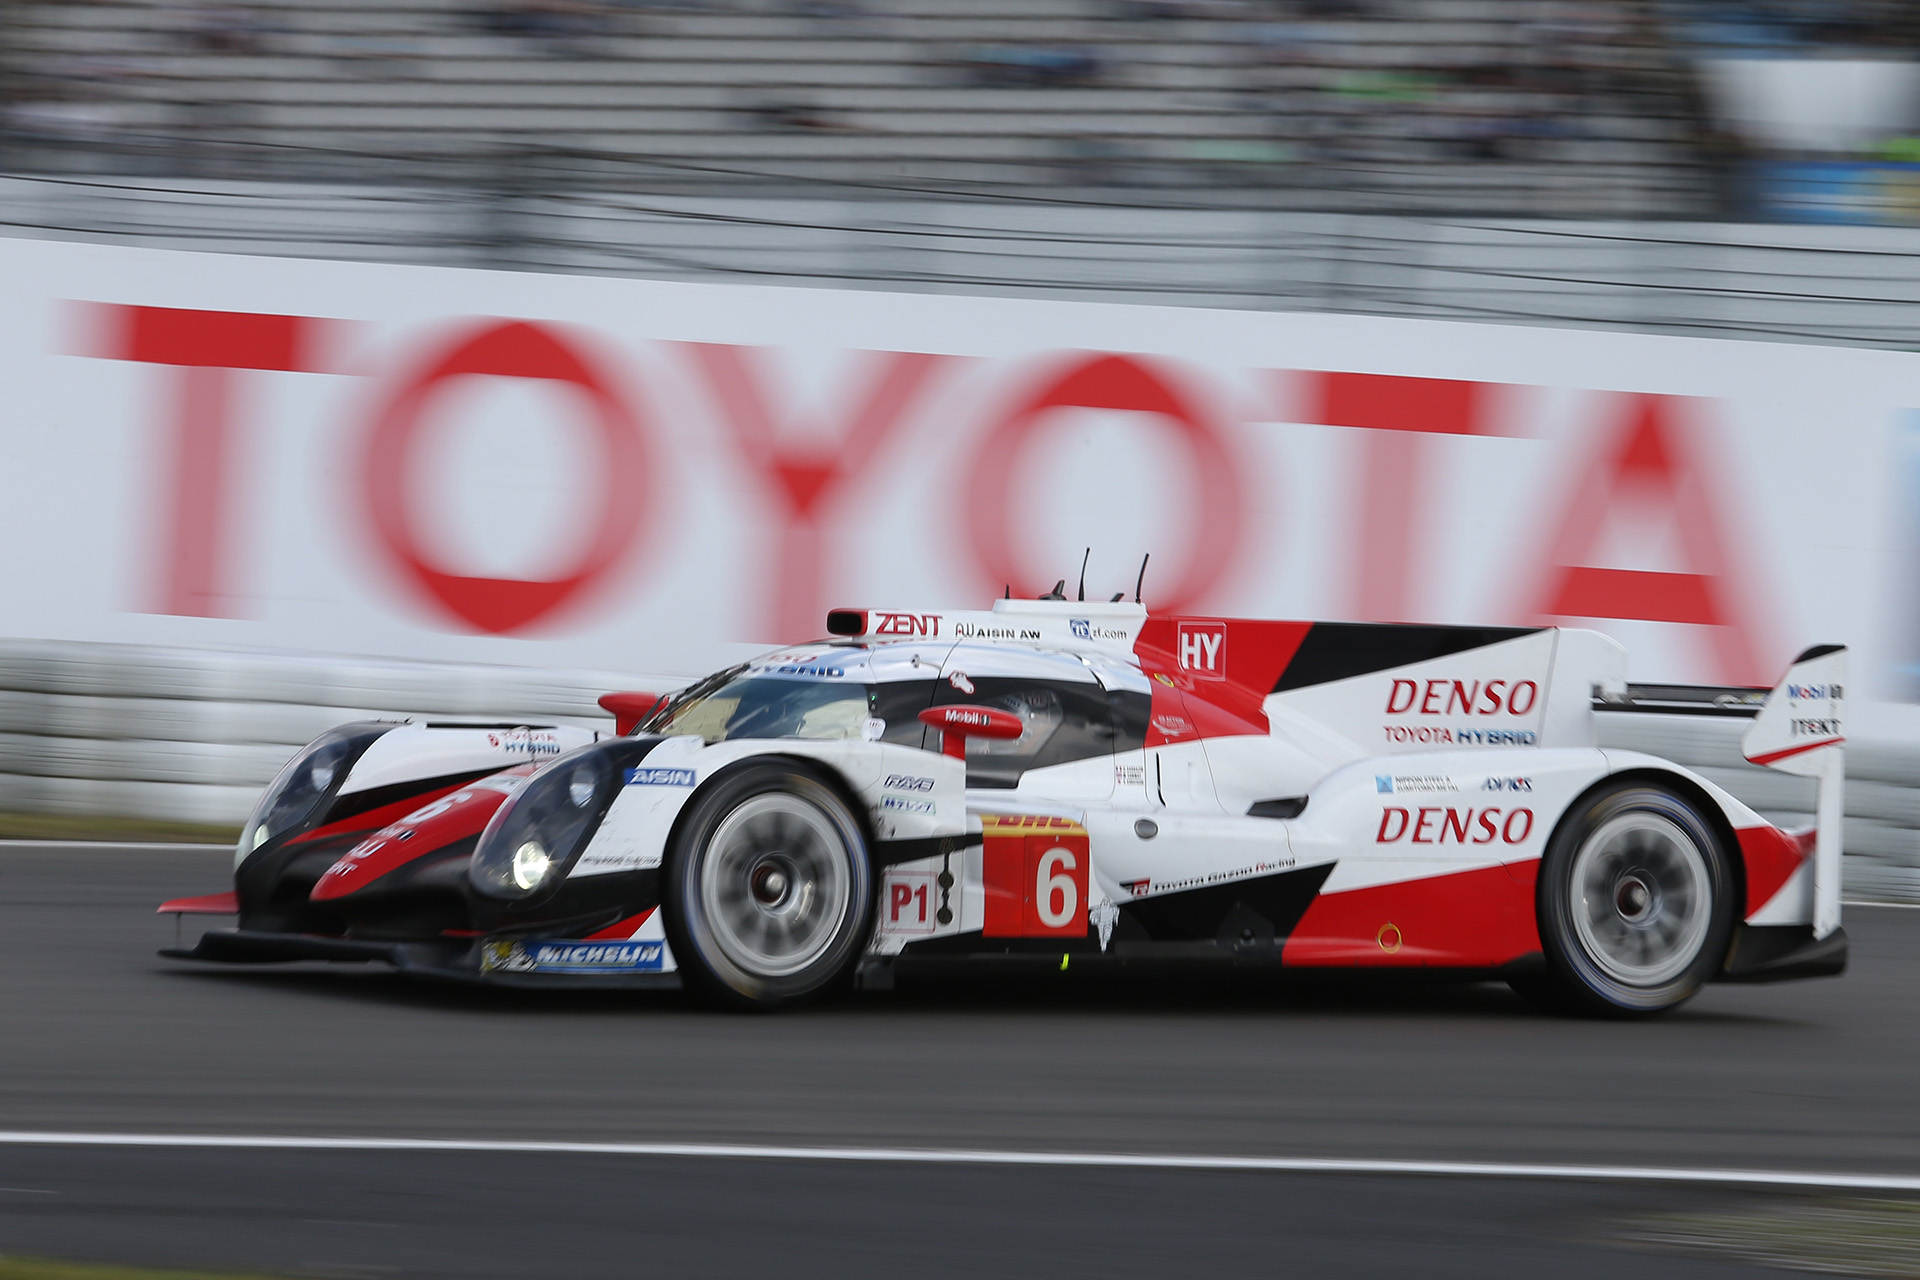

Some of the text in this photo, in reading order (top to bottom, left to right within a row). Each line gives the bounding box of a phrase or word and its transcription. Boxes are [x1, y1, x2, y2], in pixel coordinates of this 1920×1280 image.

[70, 298, 1770, 690] TOYOTA
[875, 613, 943, 636] ZENT
[976, 628, 1015, 639] AISIN
[1020, 630, 1041, 639] AW
[1180, 632, 1223, 670] HY
[1385, 678, 1538, 716] DENSO
[944, 709, 979, 724] Mobil
[1383, 725, 1538, 746] TOYOTA HYBRID
[629, 769, 693, 786] AISIN
[995, 815, 1072, 828] DHL
[1375, 806, 1534, 845] DENSO
[1035, 846, 1078, 928] 6
[1152, 876, 1205, 892] TOYOTA
[1255, 857, 1296, 873] Racing
[890, 882, 927, 922] P1
[535, 945, 663, 963] MICHELIN
